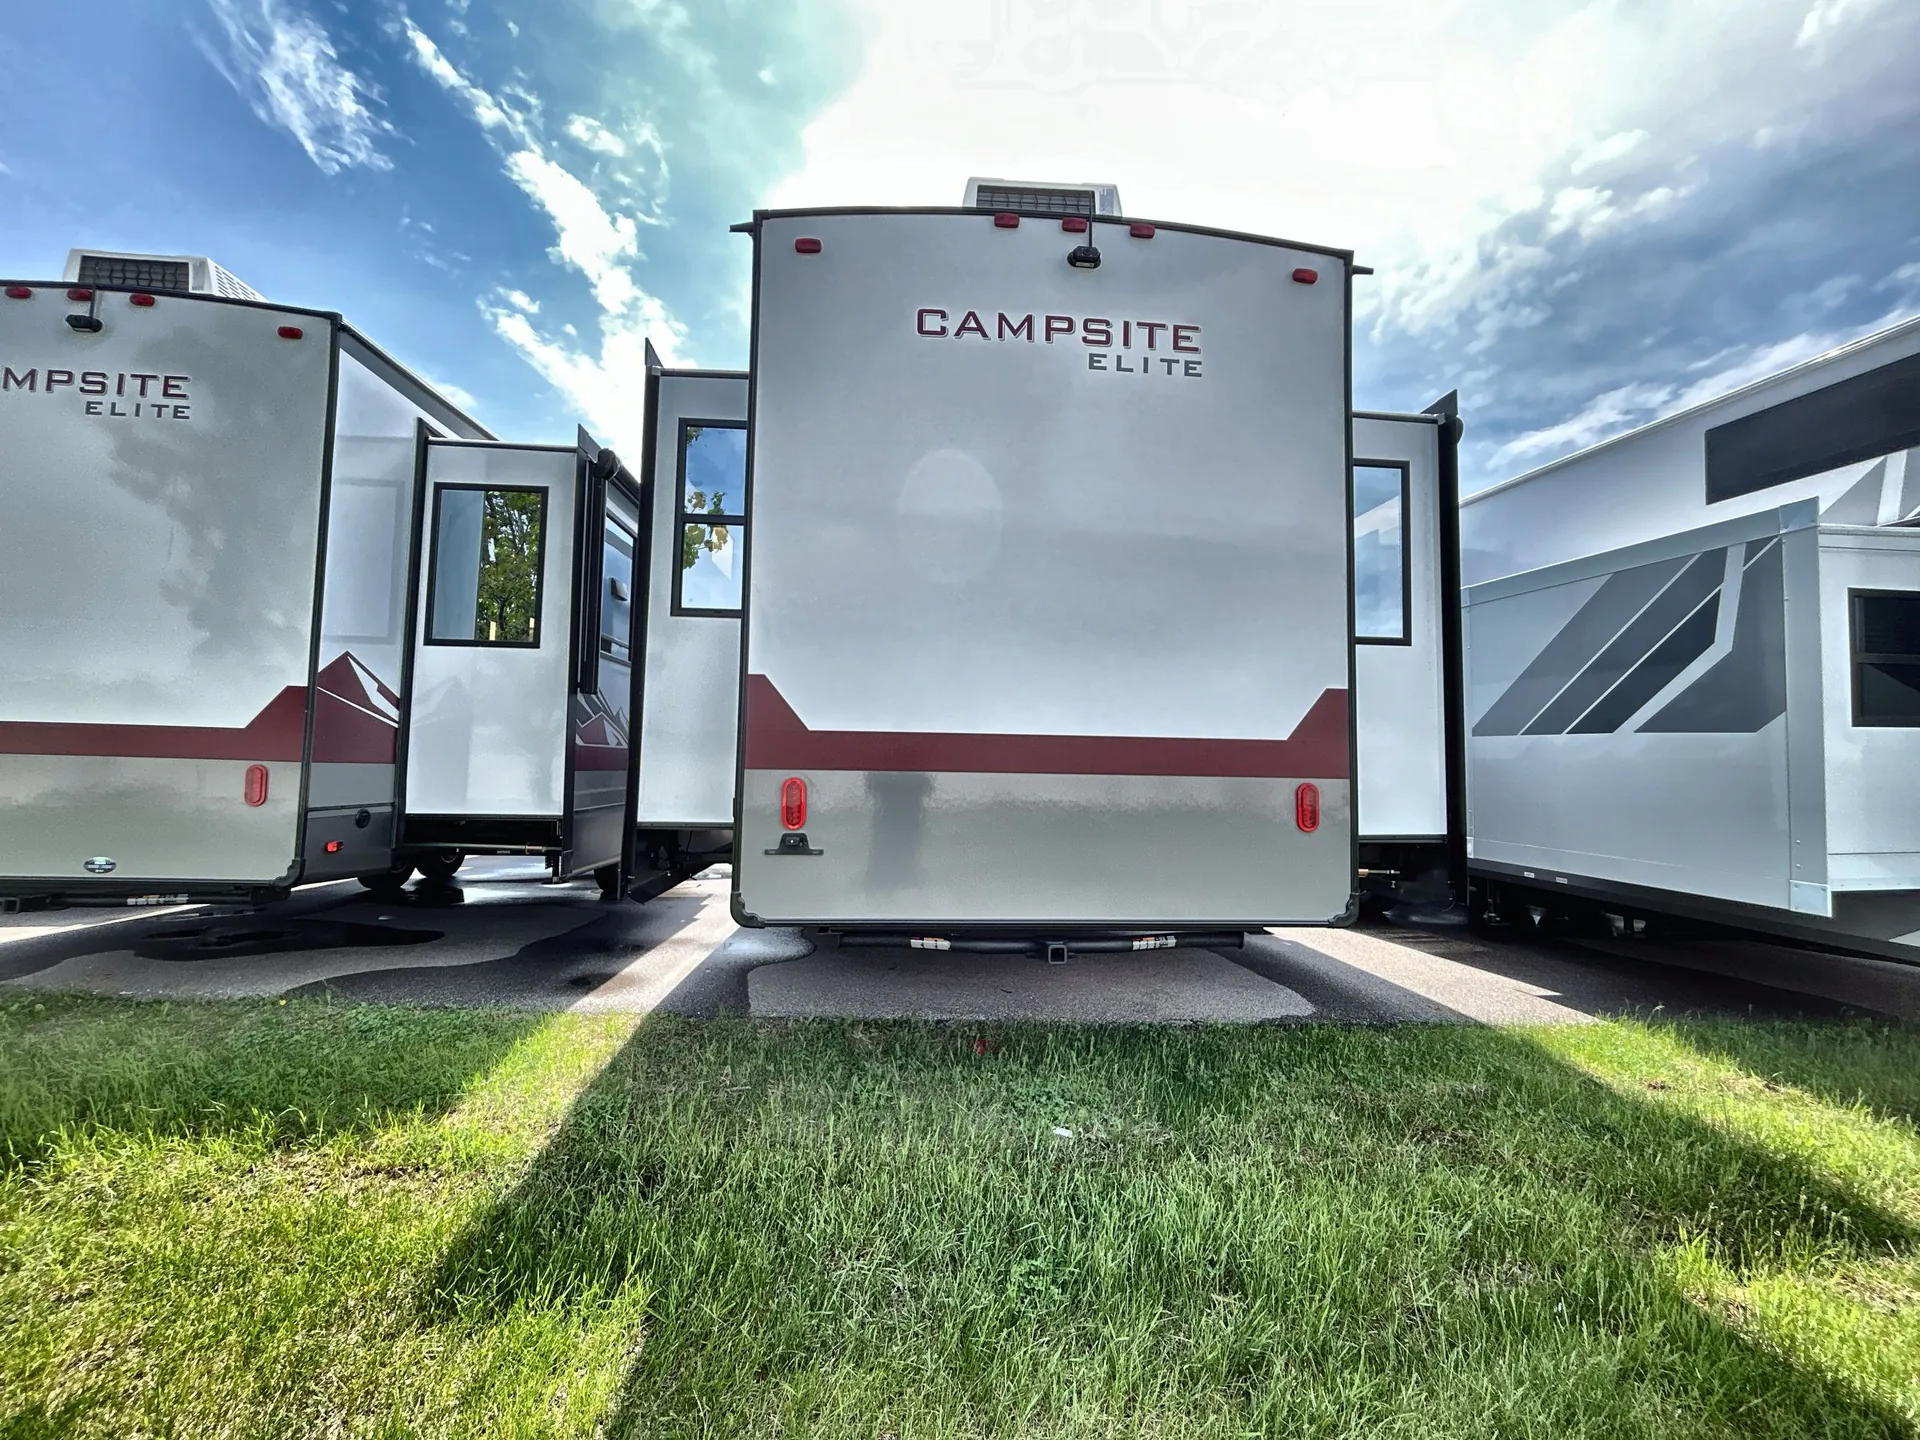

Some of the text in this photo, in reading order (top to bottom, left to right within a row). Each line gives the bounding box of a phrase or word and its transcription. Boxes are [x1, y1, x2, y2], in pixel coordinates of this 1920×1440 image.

[917, 308, 1202, 353] CAMPSITE
[1088, 353, 1202, 377] ELITE
[3, 367, 190, 399] MPSITE
[85, 401, 191, 419] ELITE
